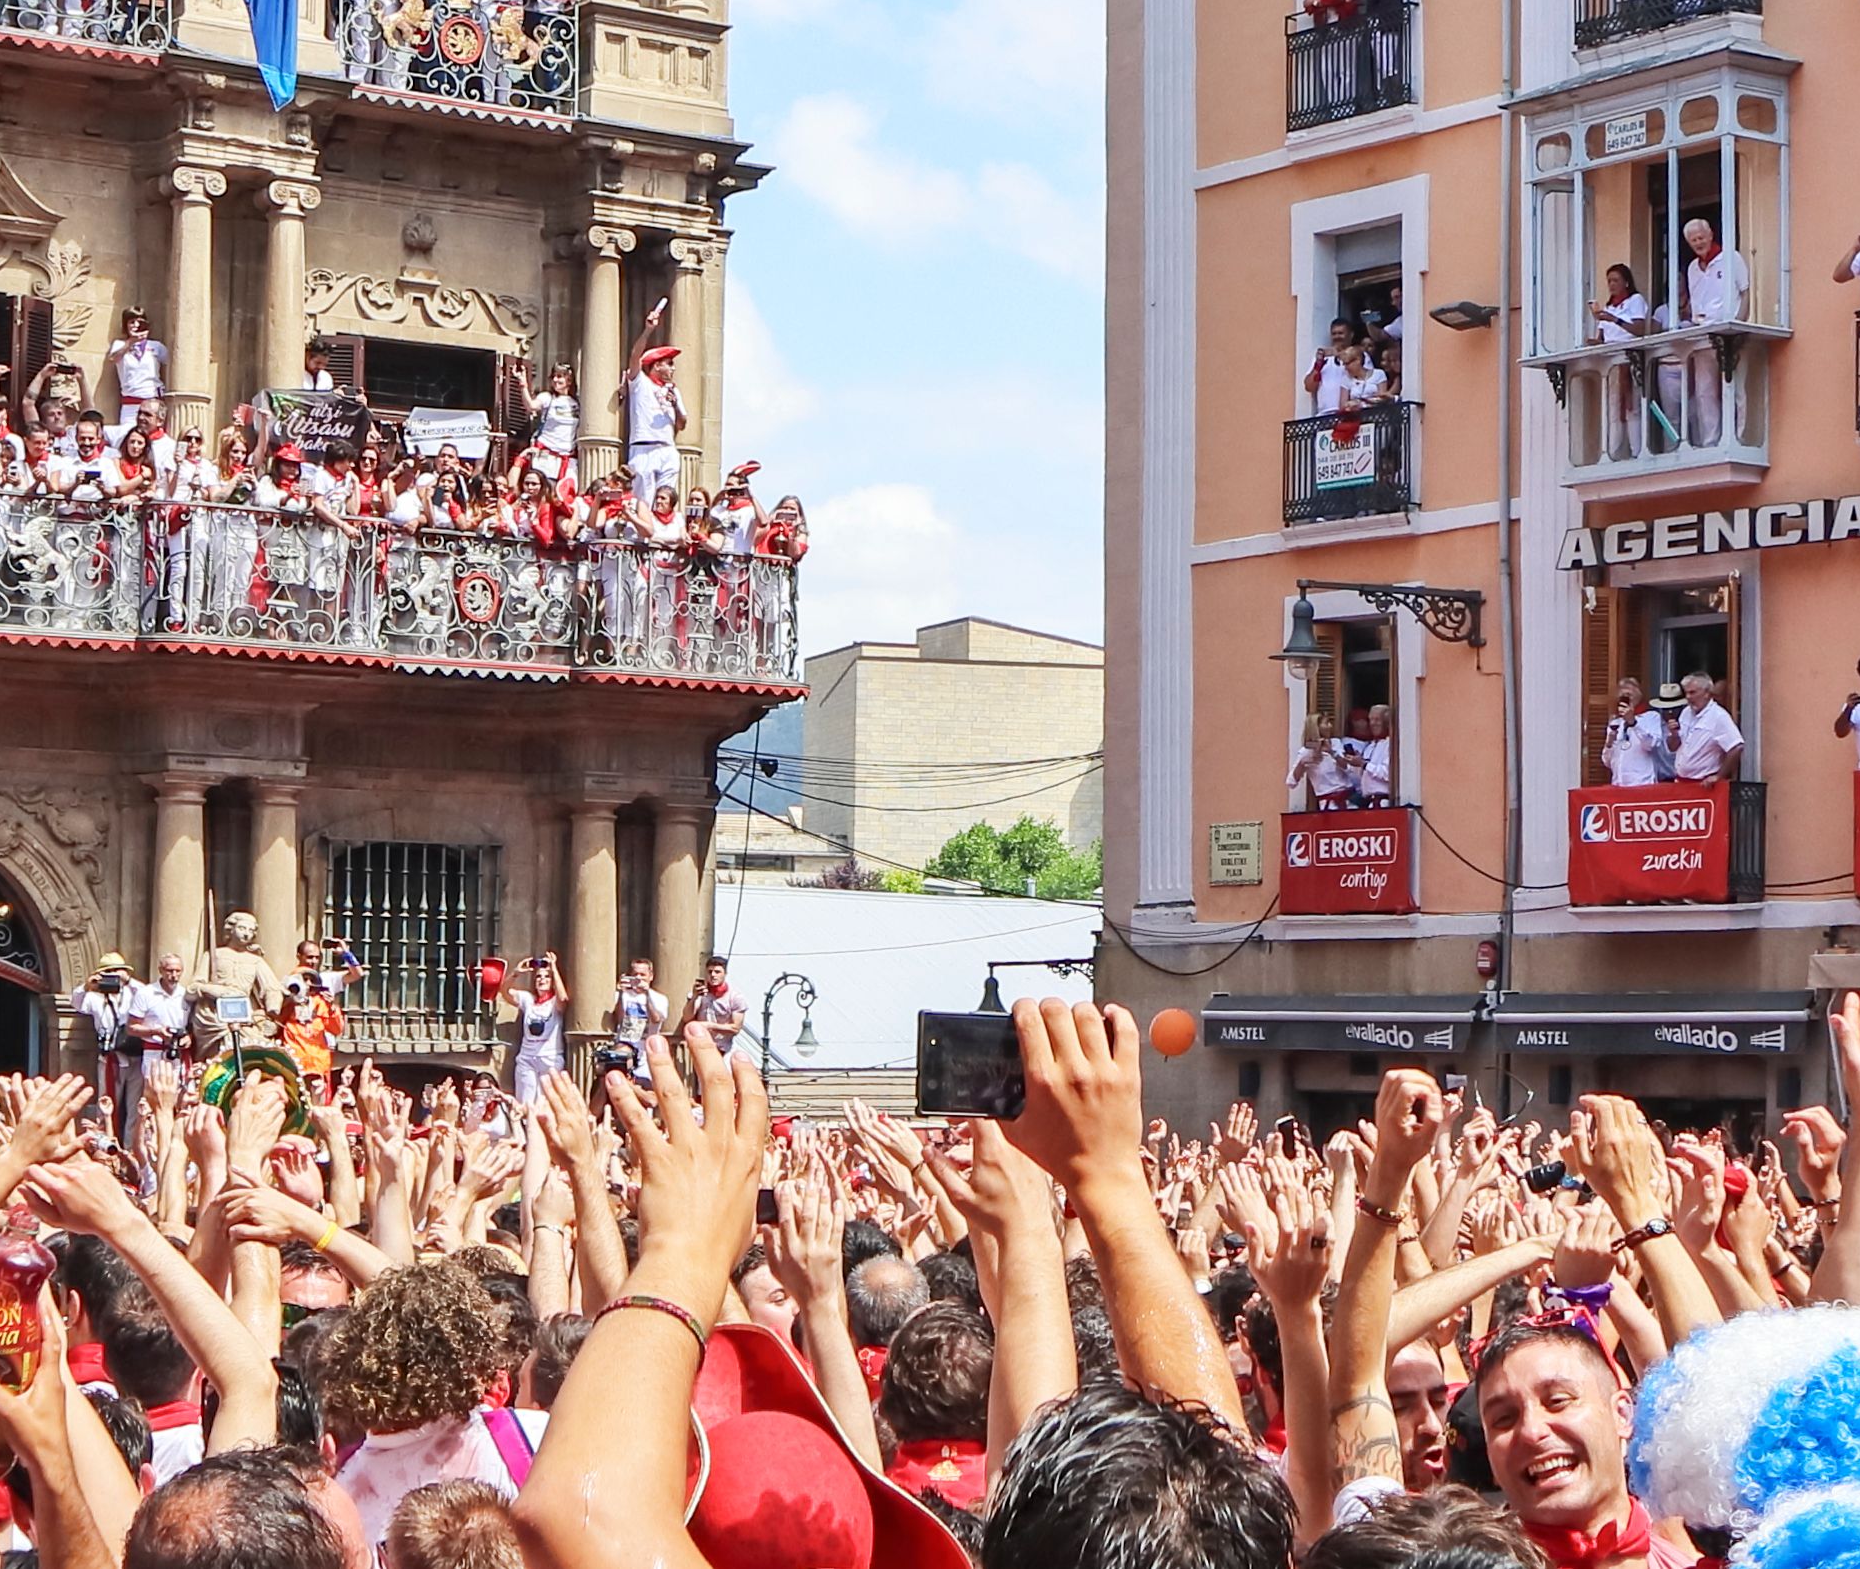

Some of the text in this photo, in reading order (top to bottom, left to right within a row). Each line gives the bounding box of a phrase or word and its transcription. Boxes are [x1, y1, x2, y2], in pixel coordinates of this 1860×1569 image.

[1618, 805, 1708, 834] EROSKI
[1319, 835, 1391, 859] EROSKI
[1642, 847, 1703, 873] zurekin
[1340, 865, 1388, 899] contigo
[1220, 1026, 1266, 1041] AMSTEL
[1516, 1030, 1569, 1046] AMSTEL
